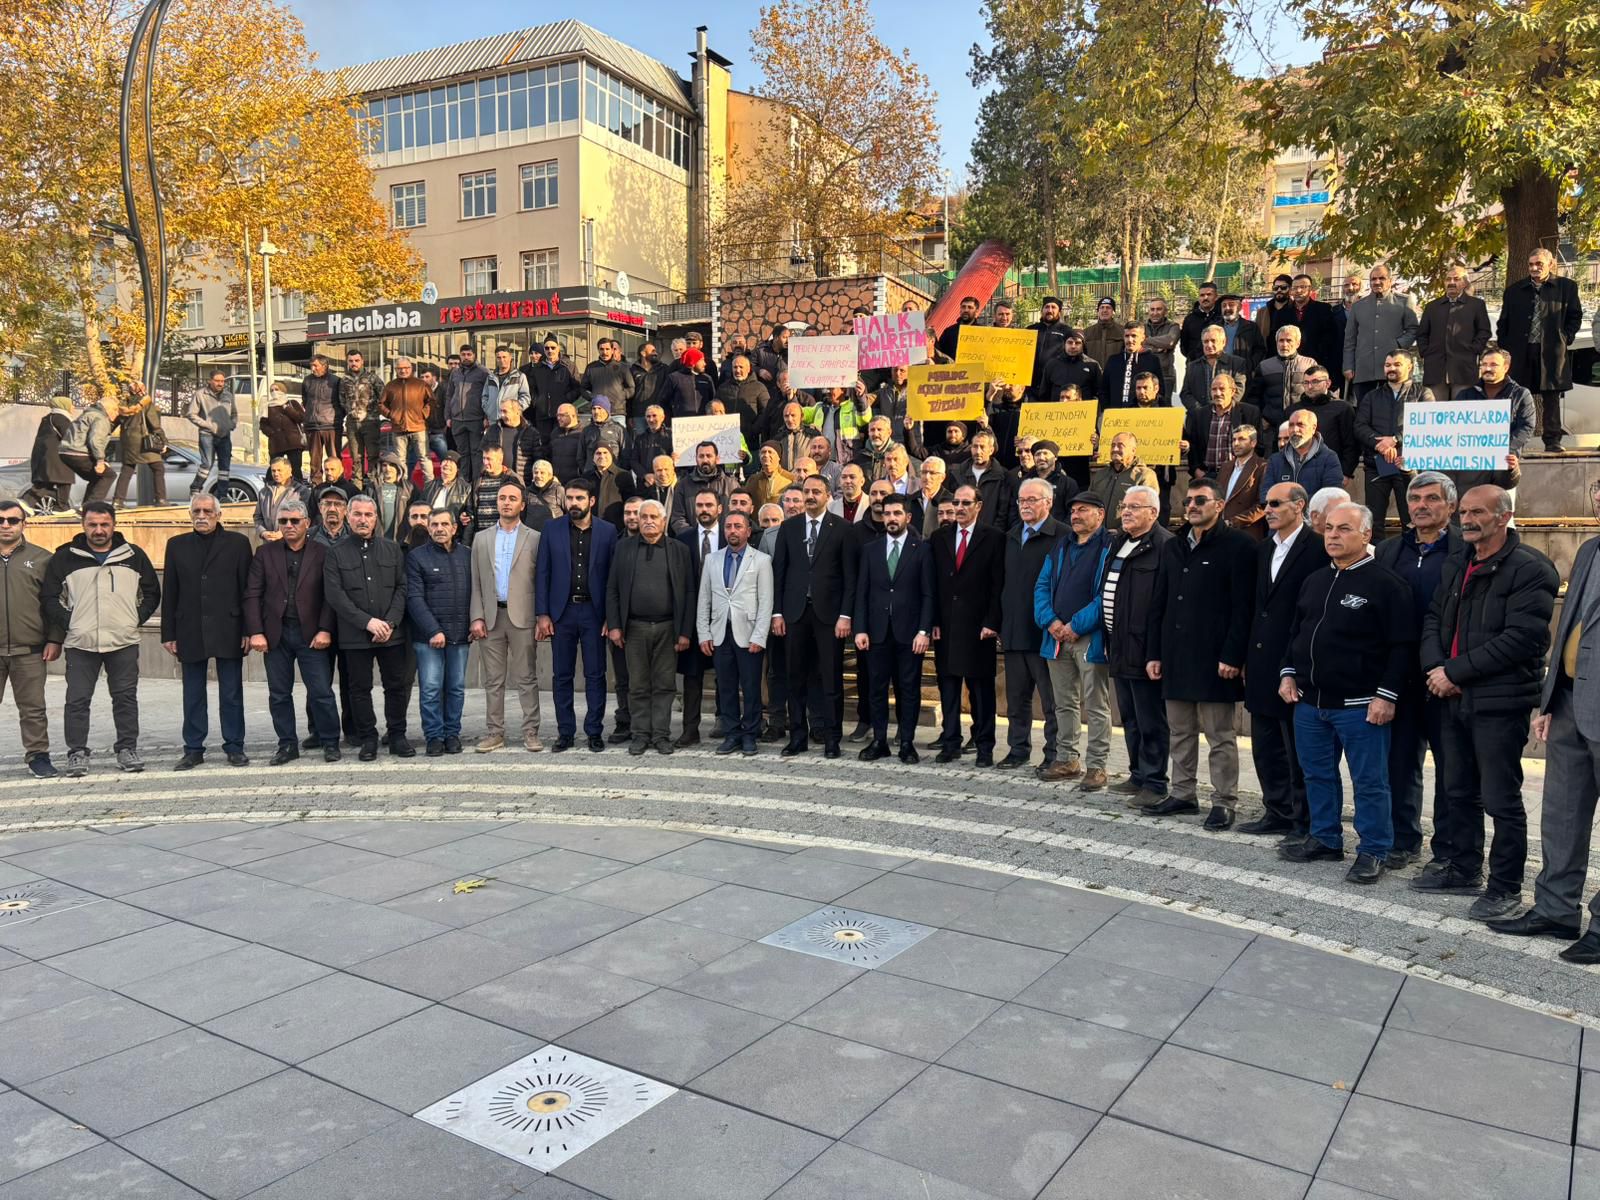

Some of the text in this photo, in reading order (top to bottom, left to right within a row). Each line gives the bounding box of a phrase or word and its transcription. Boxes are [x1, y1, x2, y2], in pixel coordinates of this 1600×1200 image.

[328, 291, 560, 334] Hacıbaba restaurant
[607, 310, 646, 327] restaurant
[854, 312, 912, 336] HALK
[791, 360, 815, 369] EMEK
[1025, 409, 1088, 421] YER ALTINDAN
[1429, 410, 1509, 425] TOPRAKLARDA
